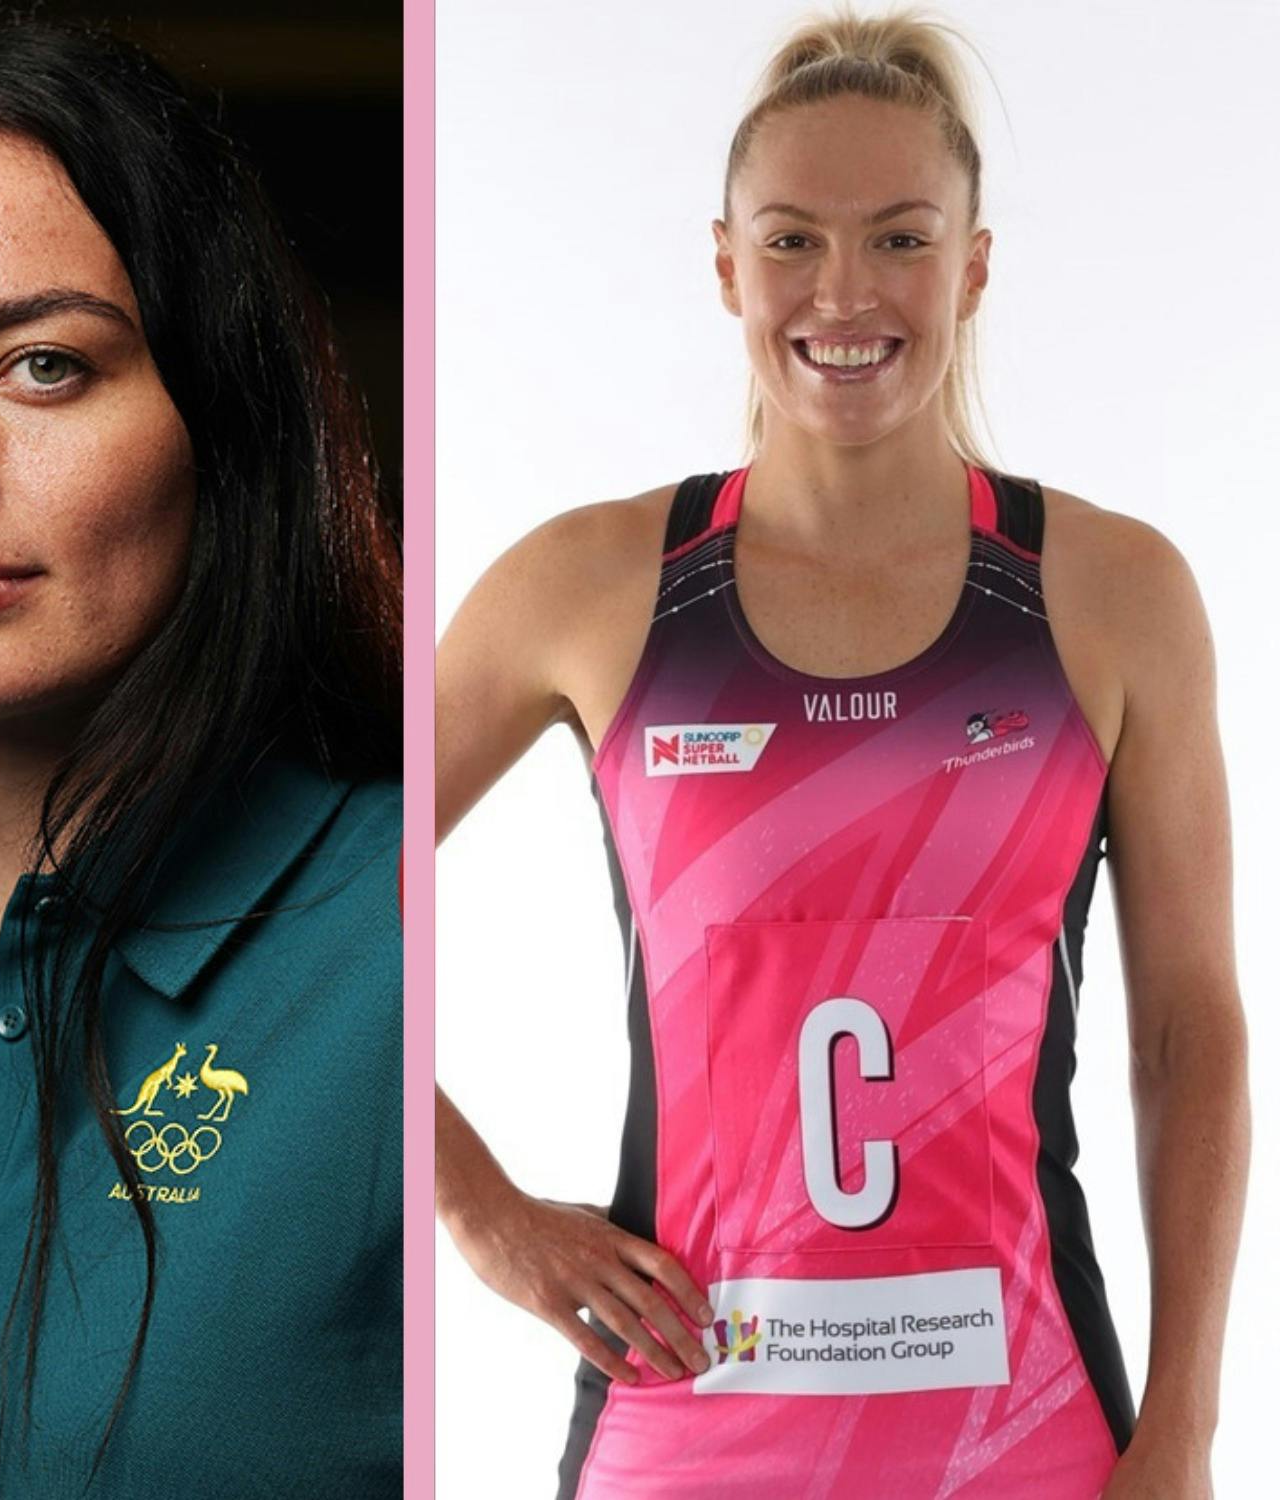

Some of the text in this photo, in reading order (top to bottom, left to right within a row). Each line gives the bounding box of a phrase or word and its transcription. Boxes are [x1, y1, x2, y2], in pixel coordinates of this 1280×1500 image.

[804, 692, 898, 722] VALOUR
[683, 731, 742, 742] SUNCORP
[683, 742, 725, 754] SUPER
[683, 753, 741, 766] NETBALL
[942, 736, 1036, 773] Thunderbirds
[798, 997, 901, 1233] C
[766, 1308, 994, 1341] The Hospital Research
[766, 1340, 954, 1362] Foundation Group
